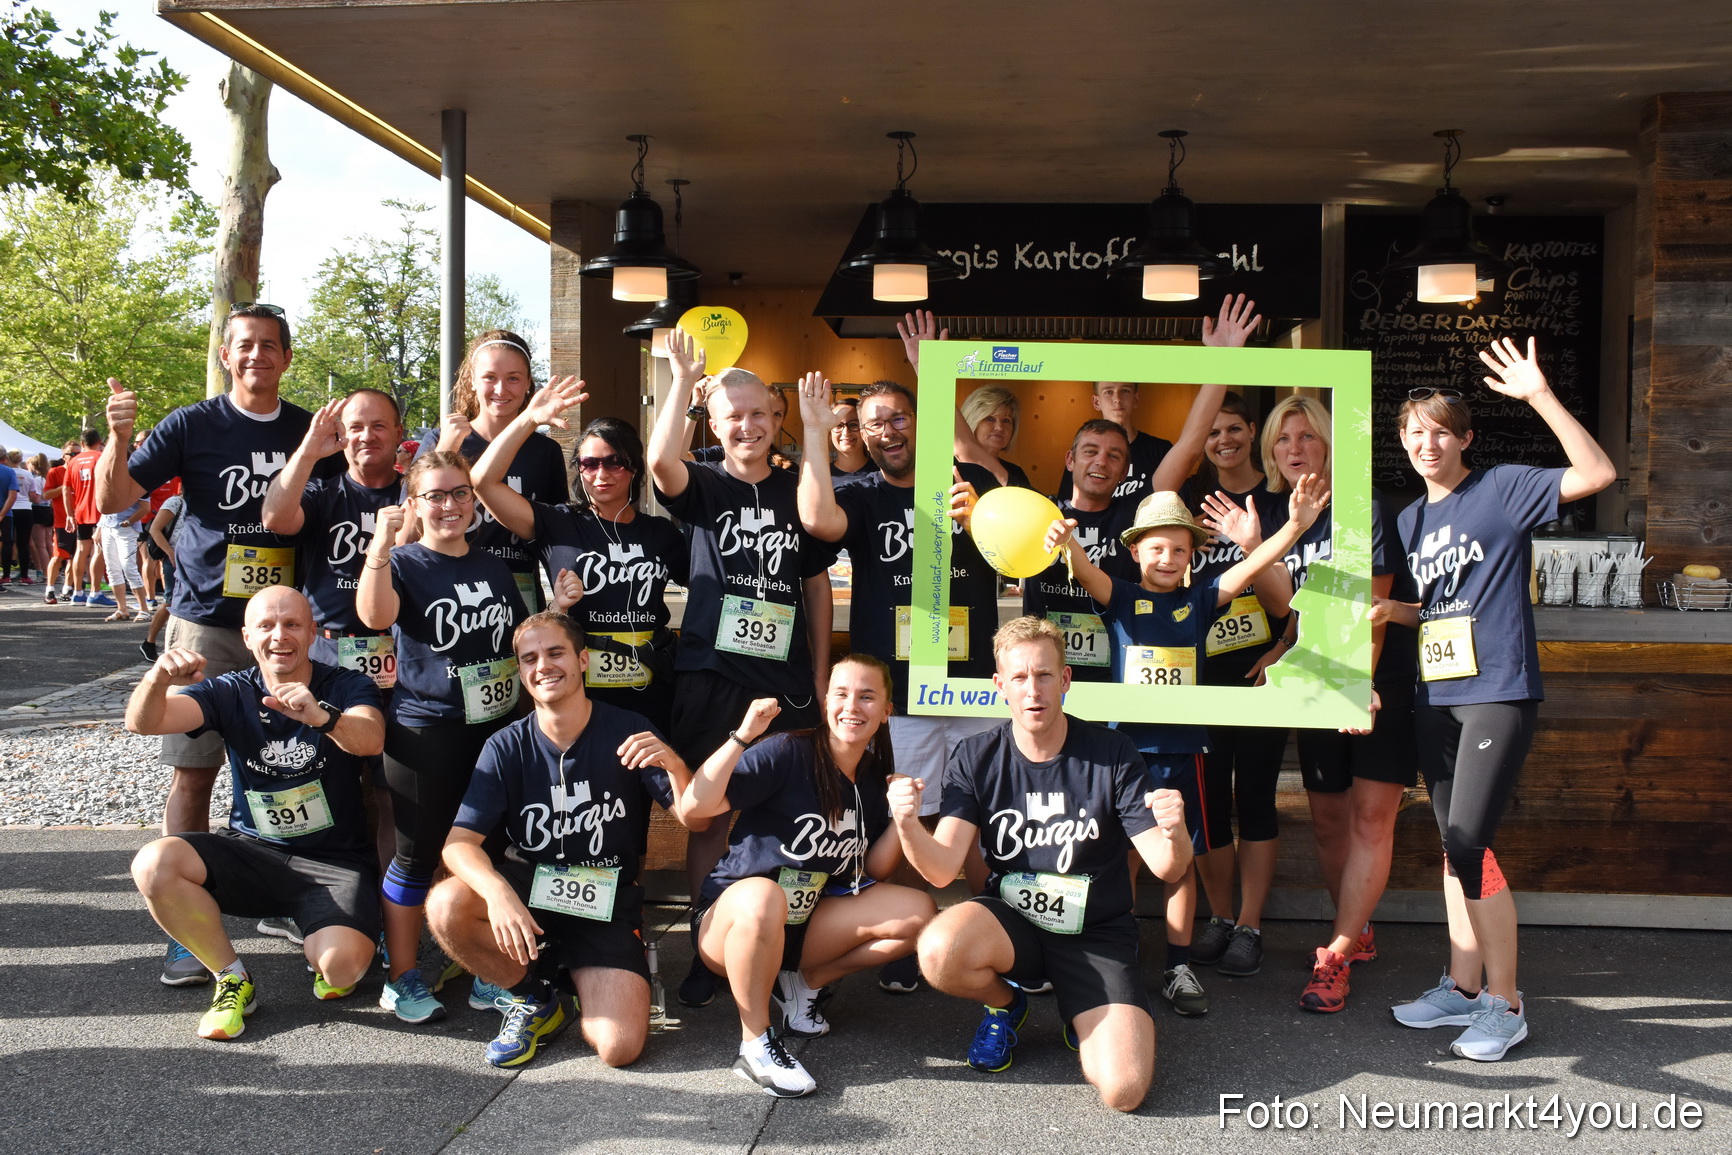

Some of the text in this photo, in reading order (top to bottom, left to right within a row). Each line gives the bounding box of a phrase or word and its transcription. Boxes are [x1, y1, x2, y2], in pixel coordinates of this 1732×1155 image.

[936, 243, 999, 280] rgis
[1503, 241, 1597, 263] KARTOFFEL
[1507, 262, 1579, 292] Chips
[1504, 291, 1550, 302] PORTION
[1503, 303, 1520, 315] XL
[701, 314, 732, 335] Burgis
[1378, 331, 1426, 346] Topping
[1430, 332, 1461, 343] nach
[978, 360, 1044, 374] firmenlauf
[716, 510, 800, 575] Burgis
[241, 566, 282, 585] 385
[928, 490, 947, 645] www.firmenlauf-oberpfalz.de
[425, 595, 513, 653] Burgis
[735, 618, 777, 643] 393
[1213, 614, 1253, 640] 395
[732, 636, 776, 650] Meier Sebastian
[1217, 632, 1256, 646] Schmid Sandra
[1424, 639, 1456, 664] 394
[355, 654, 396, 675] 390
[1140, 667, 1182, 685] 388
[480, 678, 513, 705] 389
[917, 684, 955, 706] Ich
[266, 803, 310, 826] 391
[294, 821, 308, 830] Ingo
[519, 791, 626, 856] Burgis
[989, 808, 1100, 874] Burgis
[550, 878, 597, 903] 396
[1065, 889, 1082, 898] 2019
[546, 895, 597, 910] Schmidt Thomas
[1017, 888, 1065, 917] 384
[1039, 913, 1065, 924] Thomas
